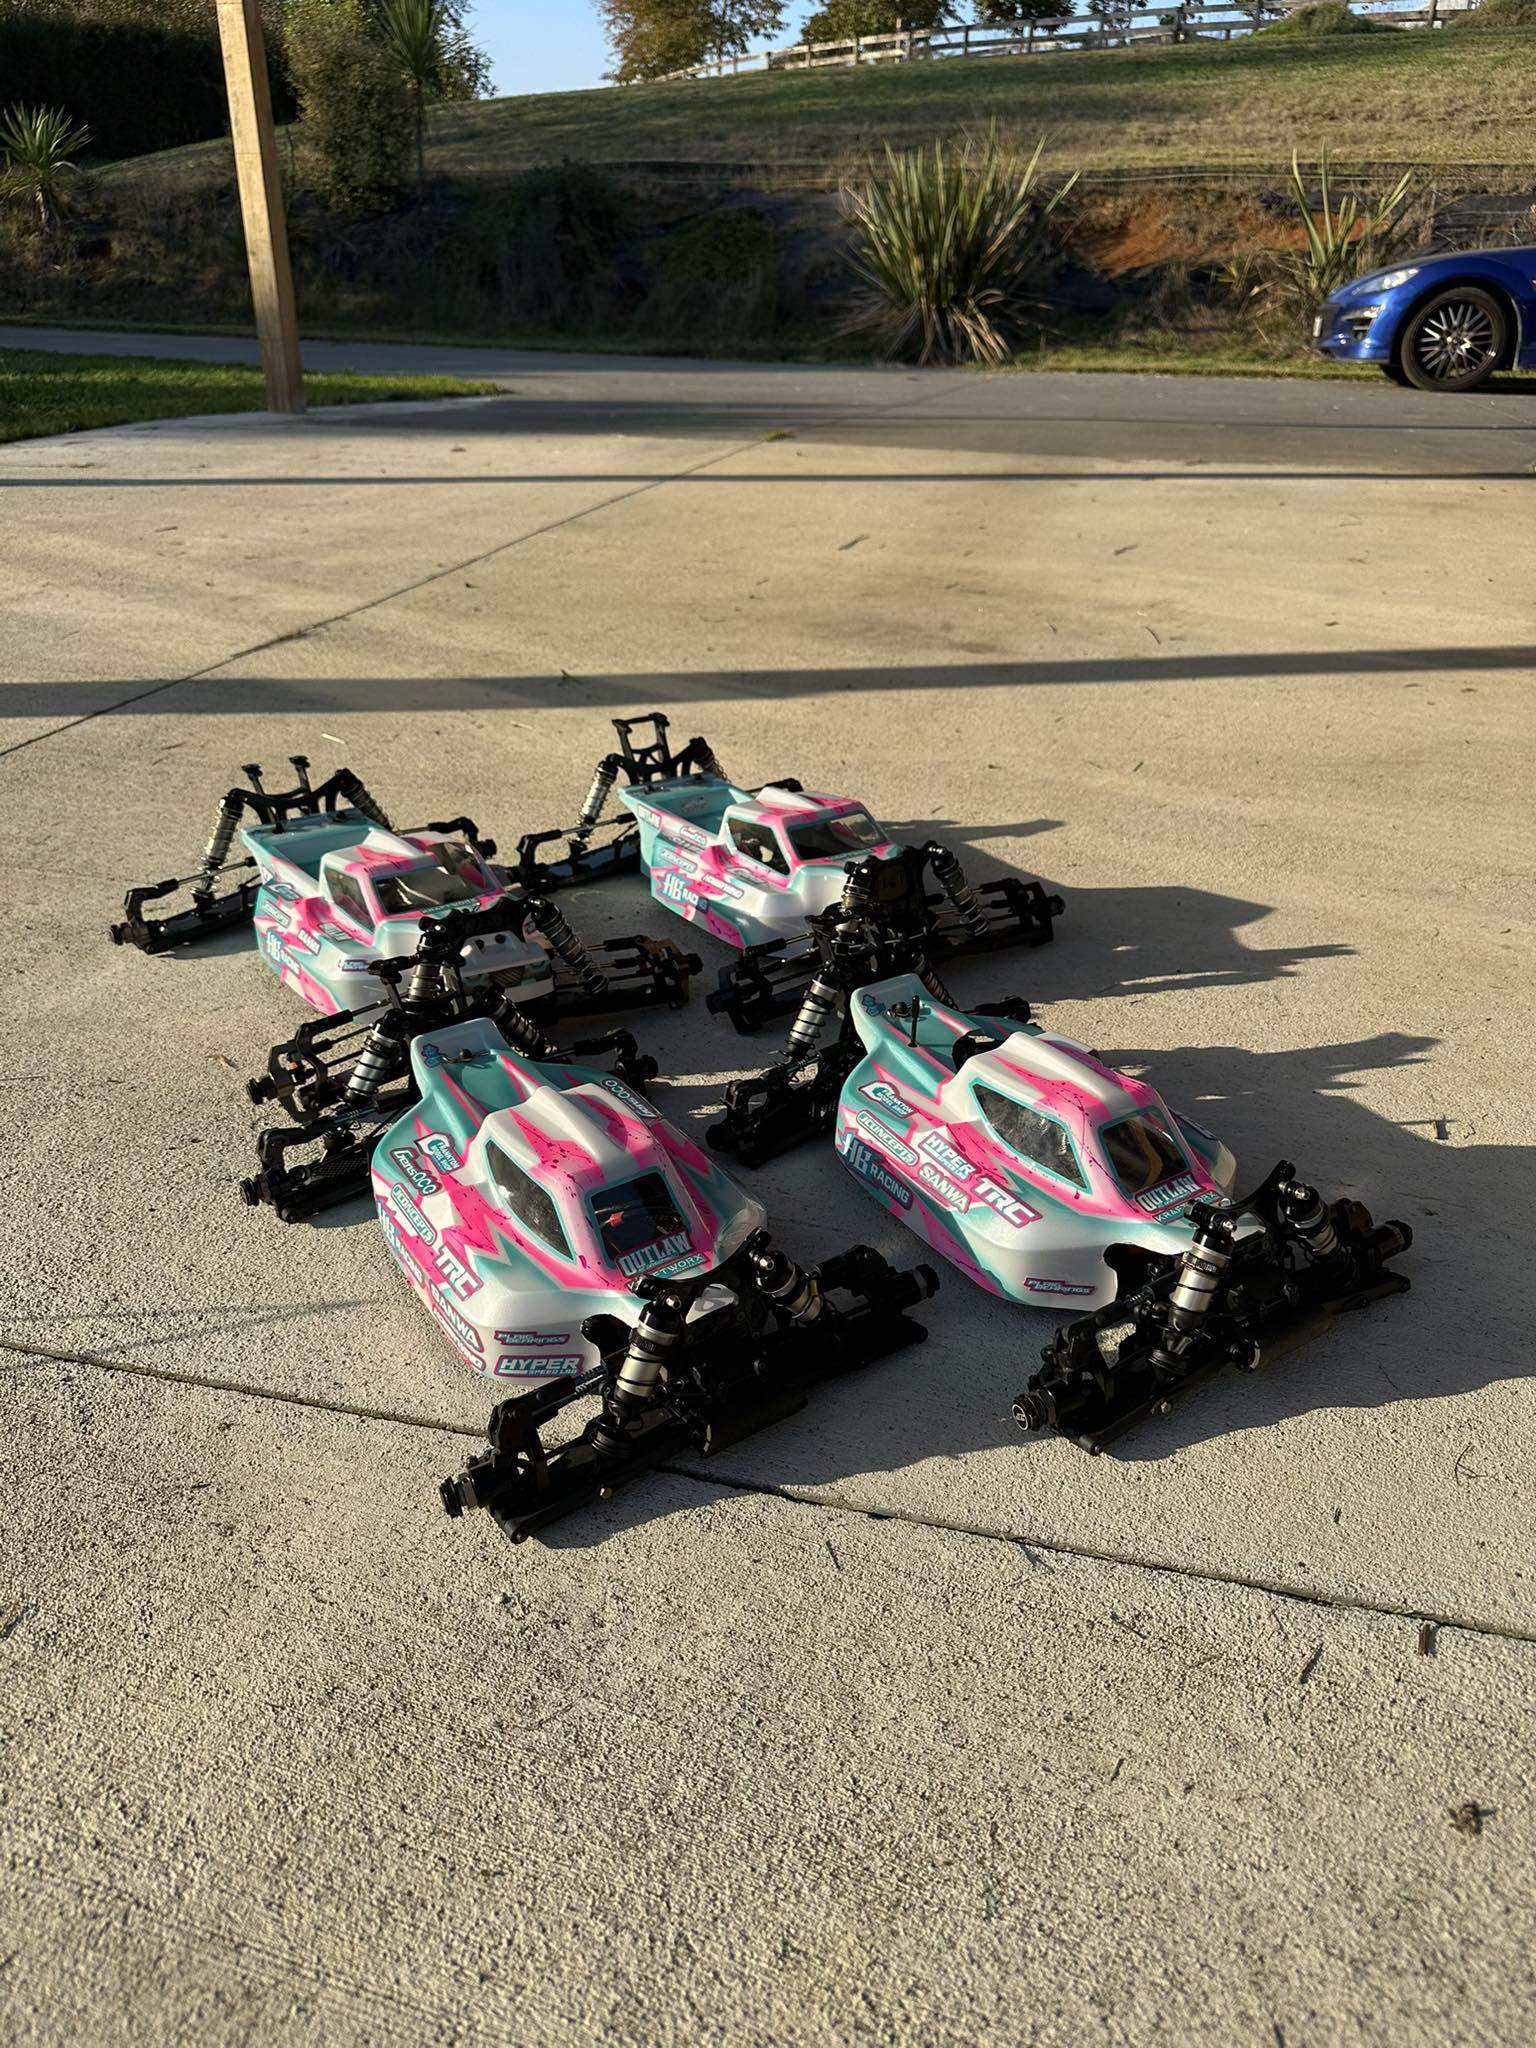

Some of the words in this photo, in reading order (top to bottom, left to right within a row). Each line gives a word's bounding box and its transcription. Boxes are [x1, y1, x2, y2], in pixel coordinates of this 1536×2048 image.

[437, 1142, 460, 1169] FRANKTON
[861, 1115, 915, 1164] JCONCEPTS
[926, 1135, 976, 1176] HYPER
[843, 1133, 873, 1175] HB
[870, 1164, 909, 1203] RACING
[919, 1165, 968, 1211] SANWA
[395, 1187, 433, 1243] JCONCEPTS
[975, 1178, 1036, 1224] TRC
[1137, 1175, 1200, 1211] OUTLAW
[435, 1245, 478, 1298] TRC
[619, 1232, 694, 1276] OUTLAW
[430, 1283, 480, 1350] SANWA
[500, 1358, 580, 1370] HYPER
